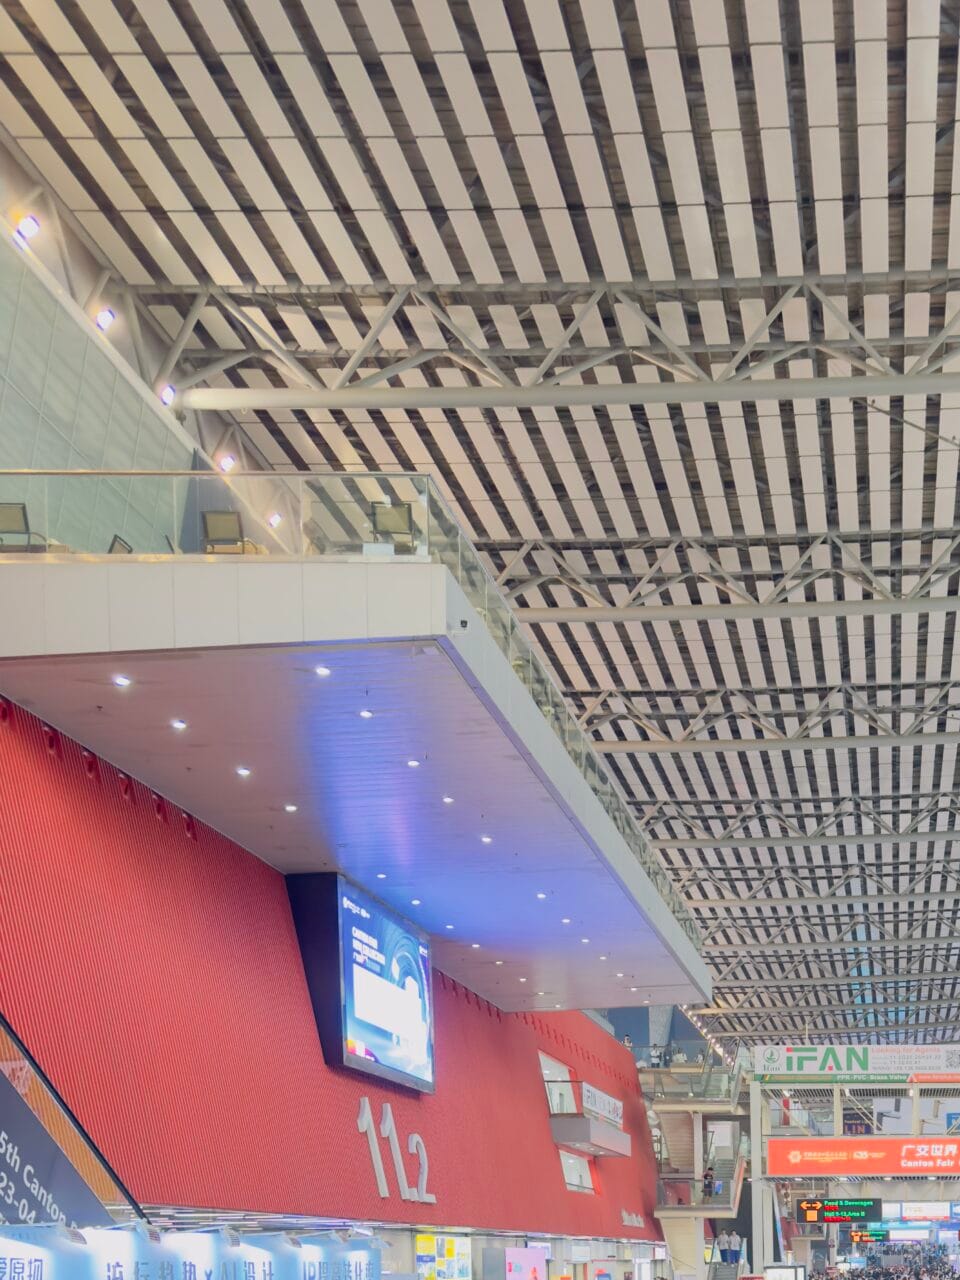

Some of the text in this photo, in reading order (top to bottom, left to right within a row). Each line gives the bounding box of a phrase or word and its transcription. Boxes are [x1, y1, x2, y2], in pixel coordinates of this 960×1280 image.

[901, 1144, 958, 1157] 广交世界
[901, 1160, 934, 1168] Canton
[936, 1159, 955, 1168] Fair
